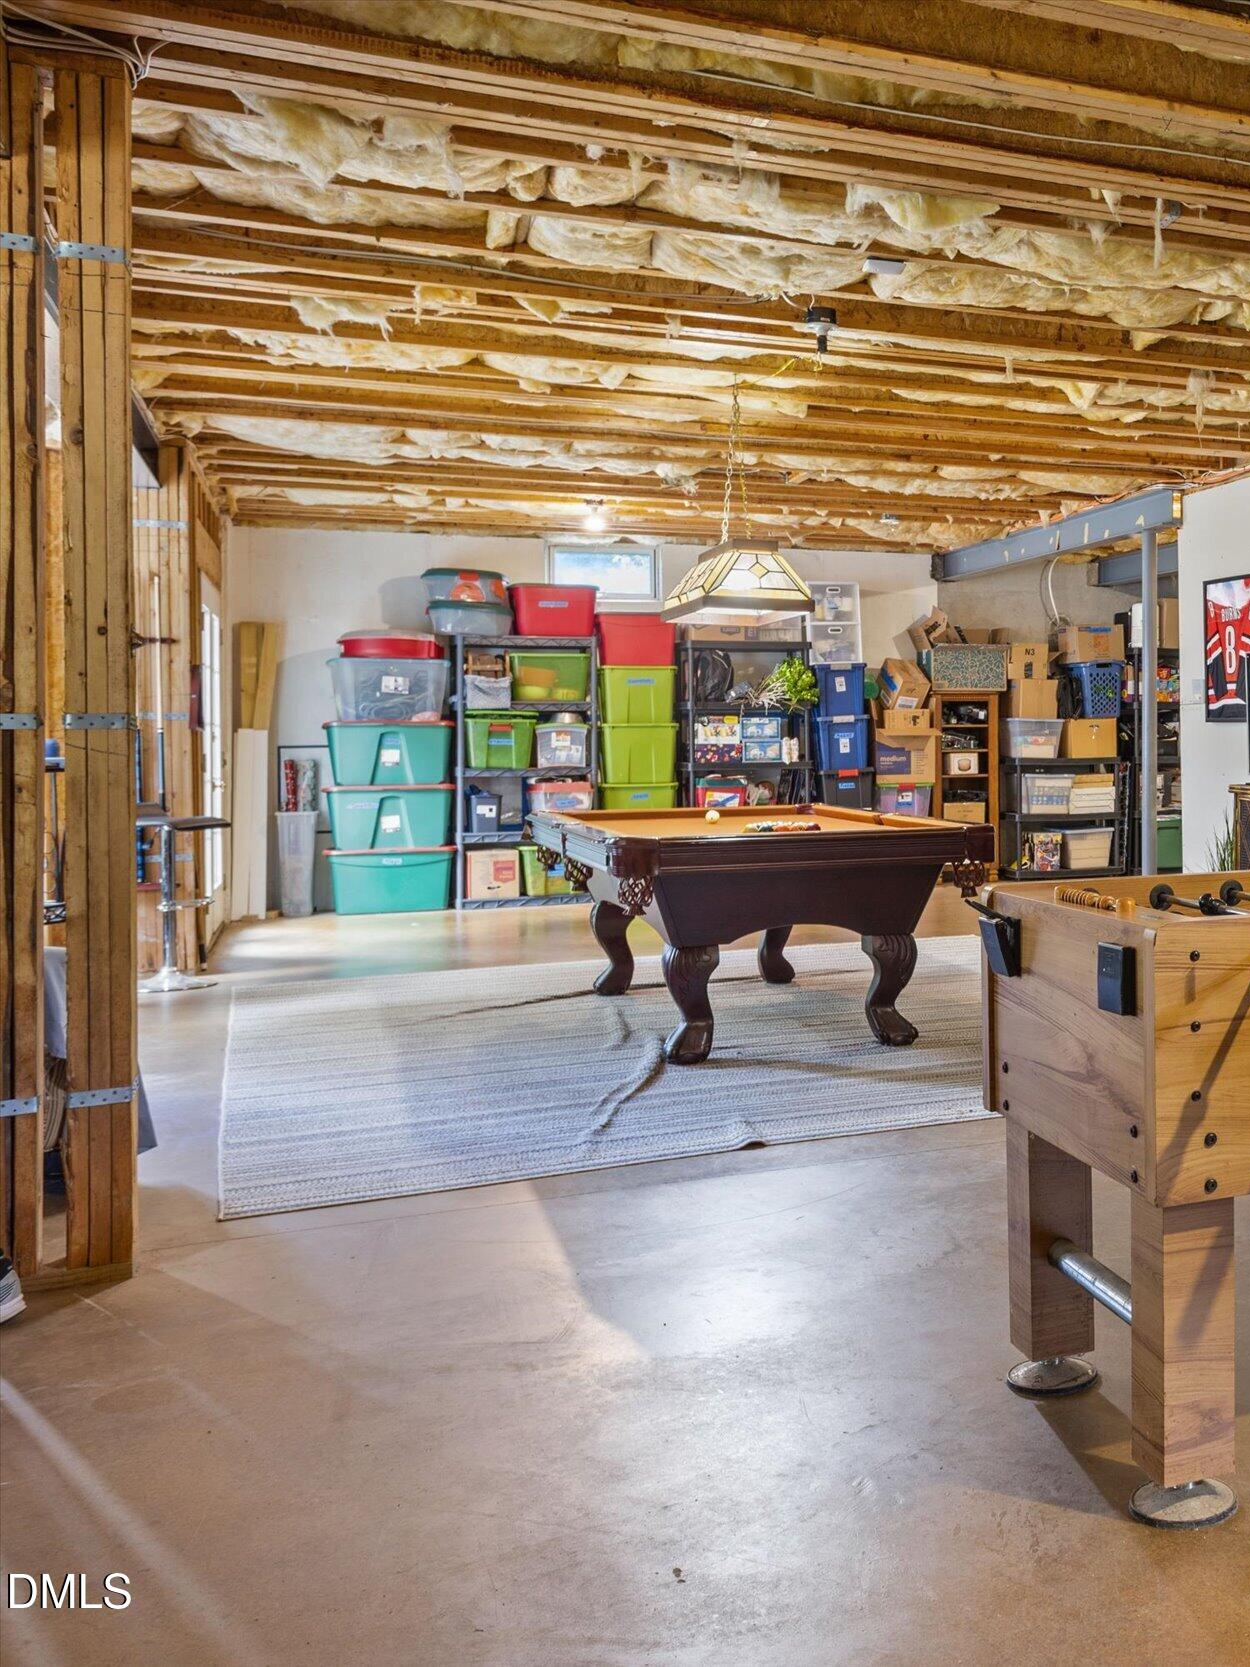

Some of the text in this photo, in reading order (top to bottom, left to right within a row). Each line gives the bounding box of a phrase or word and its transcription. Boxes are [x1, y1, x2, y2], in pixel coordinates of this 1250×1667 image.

[1221, 607, 1241, 621] BURNS
[1024, 648, 1036, 656] N3
[1226, 626, 1236, 673] 8
